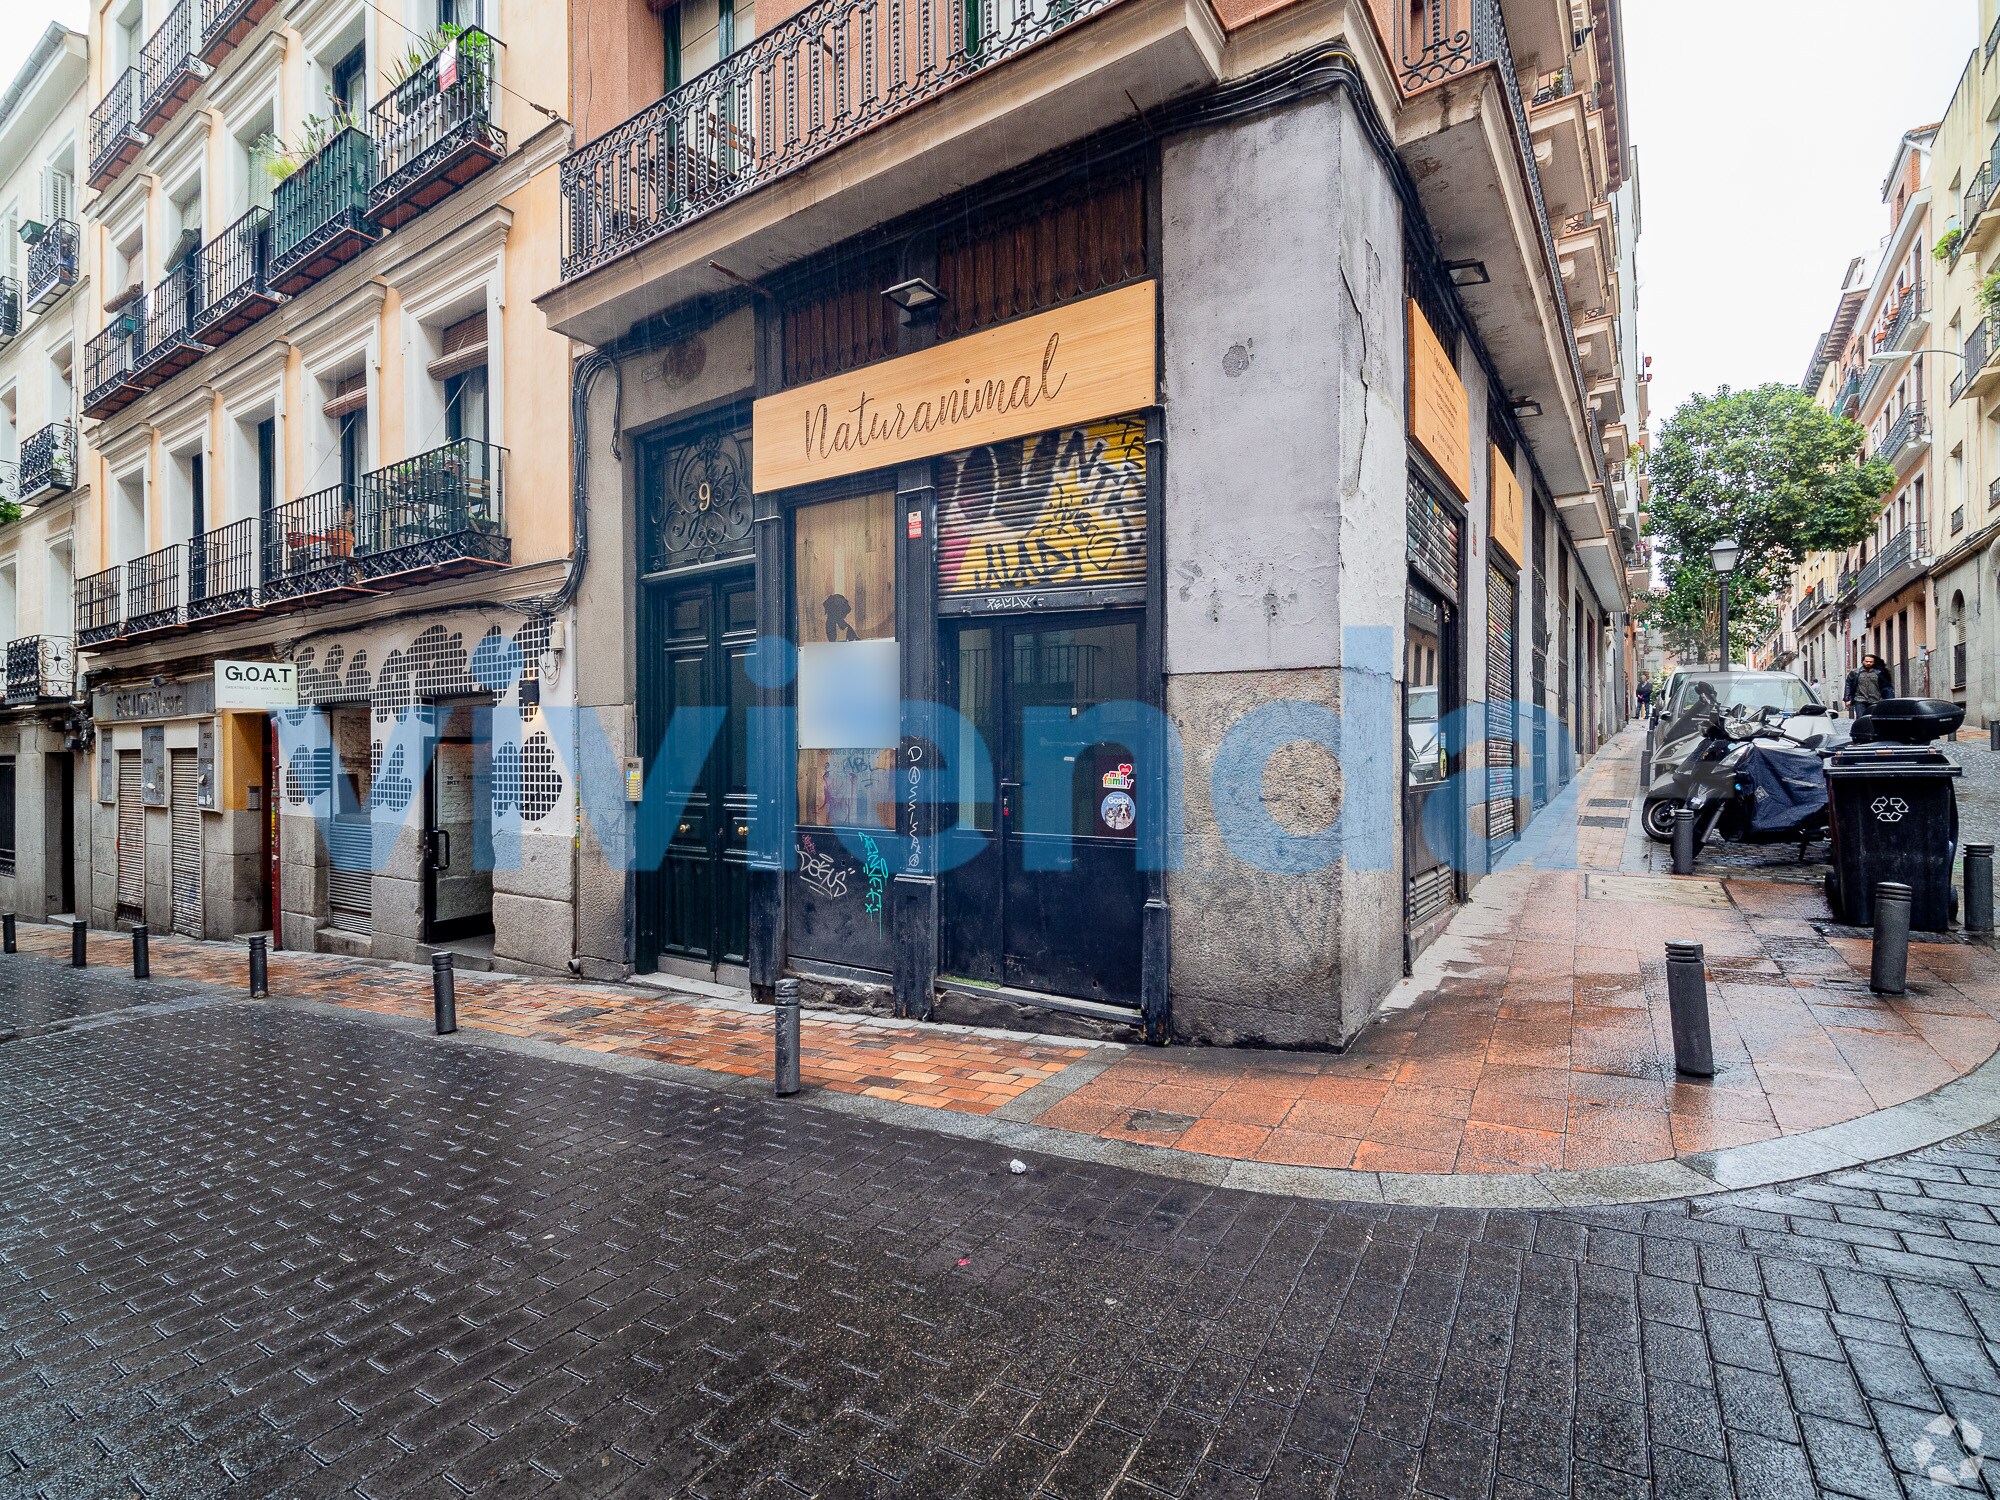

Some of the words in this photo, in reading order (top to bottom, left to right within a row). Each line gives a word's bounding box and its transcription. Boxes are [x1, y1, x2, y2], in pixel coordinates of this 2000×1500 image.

[805, 332, 1068, 461] Naturanimal
[699, 483, 711, 511] 9
[1103, 774, 1132, 788] family
